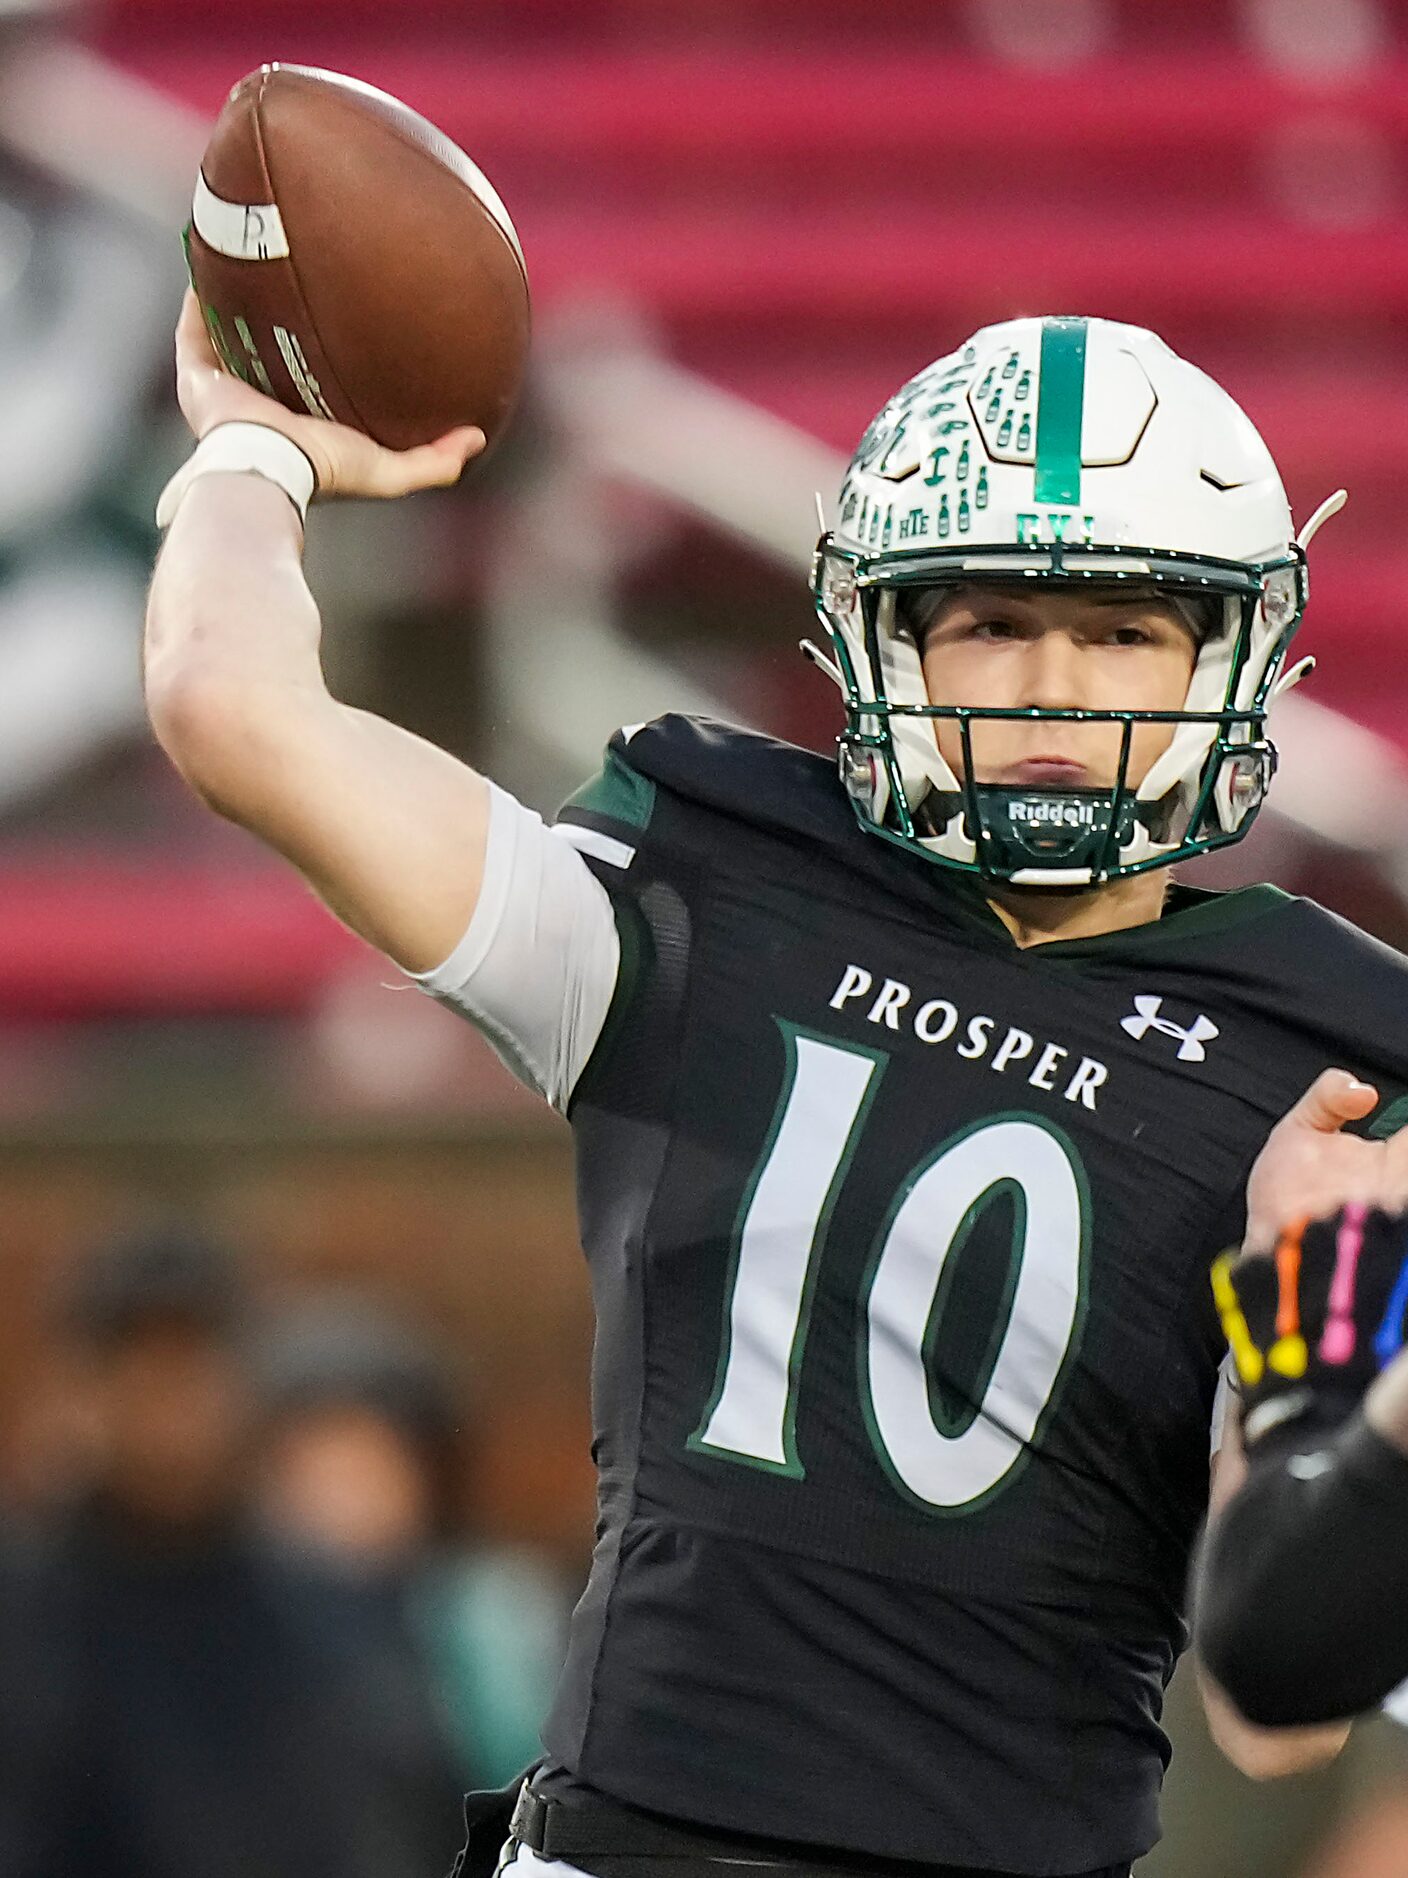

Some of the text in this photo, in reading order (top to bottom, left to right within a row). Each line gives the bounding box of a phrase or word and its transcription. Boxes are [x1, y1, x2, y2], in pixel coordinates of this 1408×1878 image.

[1008, 801, 1093, 824] Riddell
[829, 964, 1109, 1110] PROSPER
[685, 1014, 1092, 1518] 10
